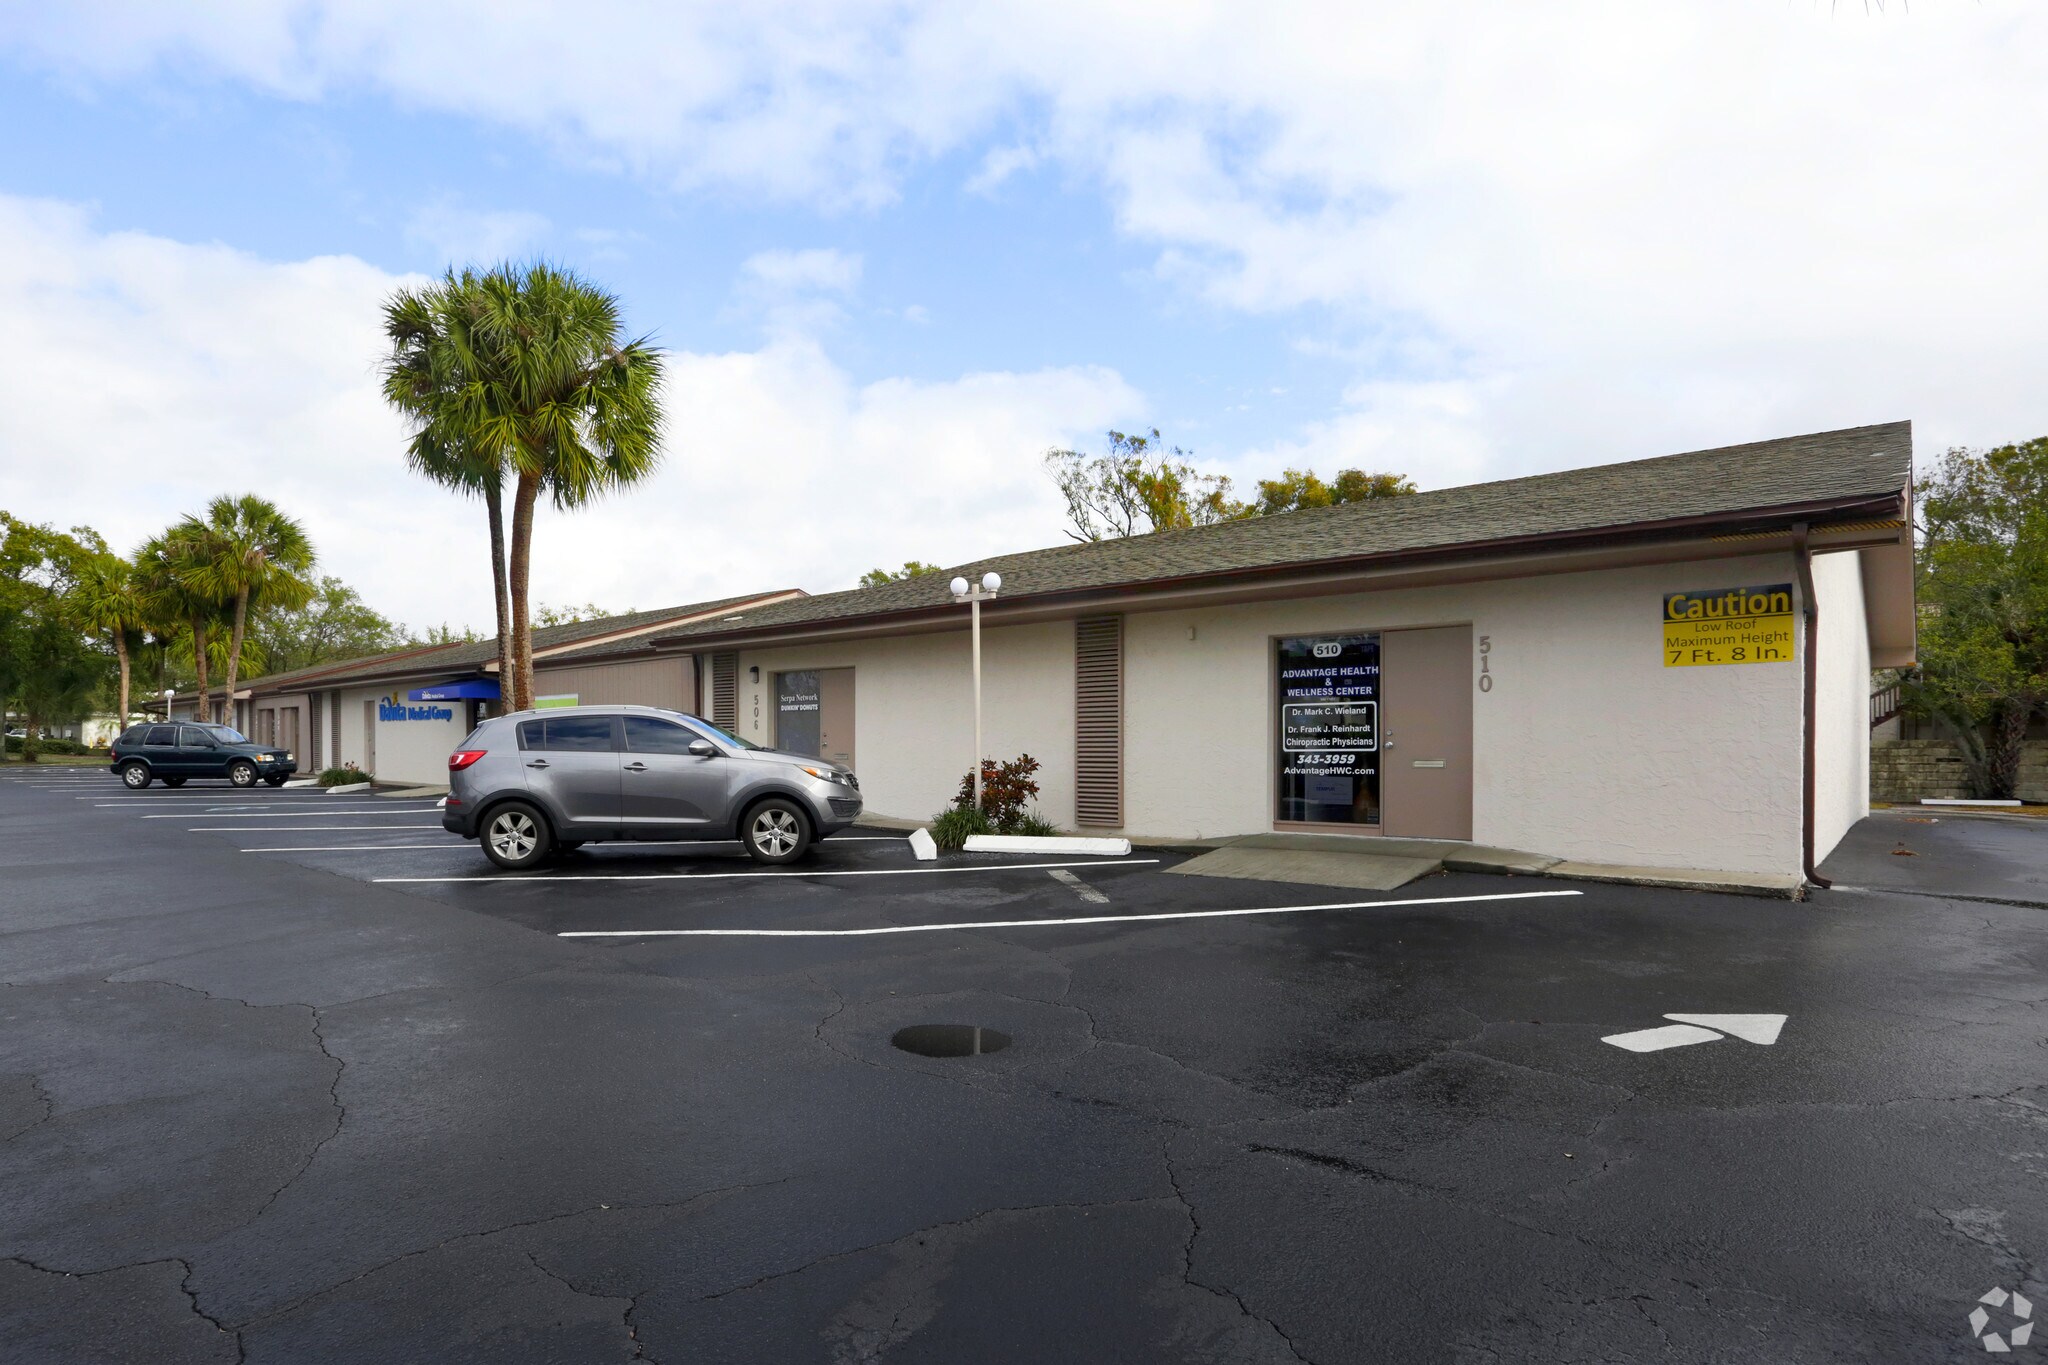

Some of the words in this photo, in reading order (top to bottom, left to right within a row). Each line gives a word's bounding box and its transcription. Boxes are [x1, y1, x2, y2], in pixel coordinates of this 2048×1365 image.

[1668, 589, 1789, 619] Caution
[1695, 622, 1721, 633] Low
[1726, 619, 1757, 631] Roof
[1666, 635, 1736, 648] Maximum
[1741, 631, 1789, 645] Height
[1316, 645, 1338, 655] 510
[1669, 651, 1682, 664] 7
[1692, 649, 1721, 662] Ft.
[1731, 647, 1746, 661] 8
[1757, 646, 1787, 660] In.
[1479, 636, 1493, 693] 510
[1282, 668, 1338, 678] ADVANTAGE
[1340, 666, 1379, 676] HEALTH
[1325, 678, 1332, 686] &
[1287, 688, 1334, 697] WELLNESS
[1336, 687, 1372, 695] CENTER
[781, 695, 795, 703] Serpa
[408, 706, 431, 720] Medical
[432, 706, 452, 722] Group
[1304, 708, 1323, 716] Mark
[1324, 707, 1333, 715] C.
[1335, 706, 1367, 715] Wieland
[1300, 725, 1322, 733] Frank
[1323, 725, 1331, 733] J.
[1332, 724, 1371, 733] Reinhardt
[1286, 737, 1331, 747] Chiropractic
[1332, 737, 1374, 748] Physicians
[1297, 755, 1355, 764] 343-3959
[1284, 767, 1374, 776] AdvantageHWC.com
